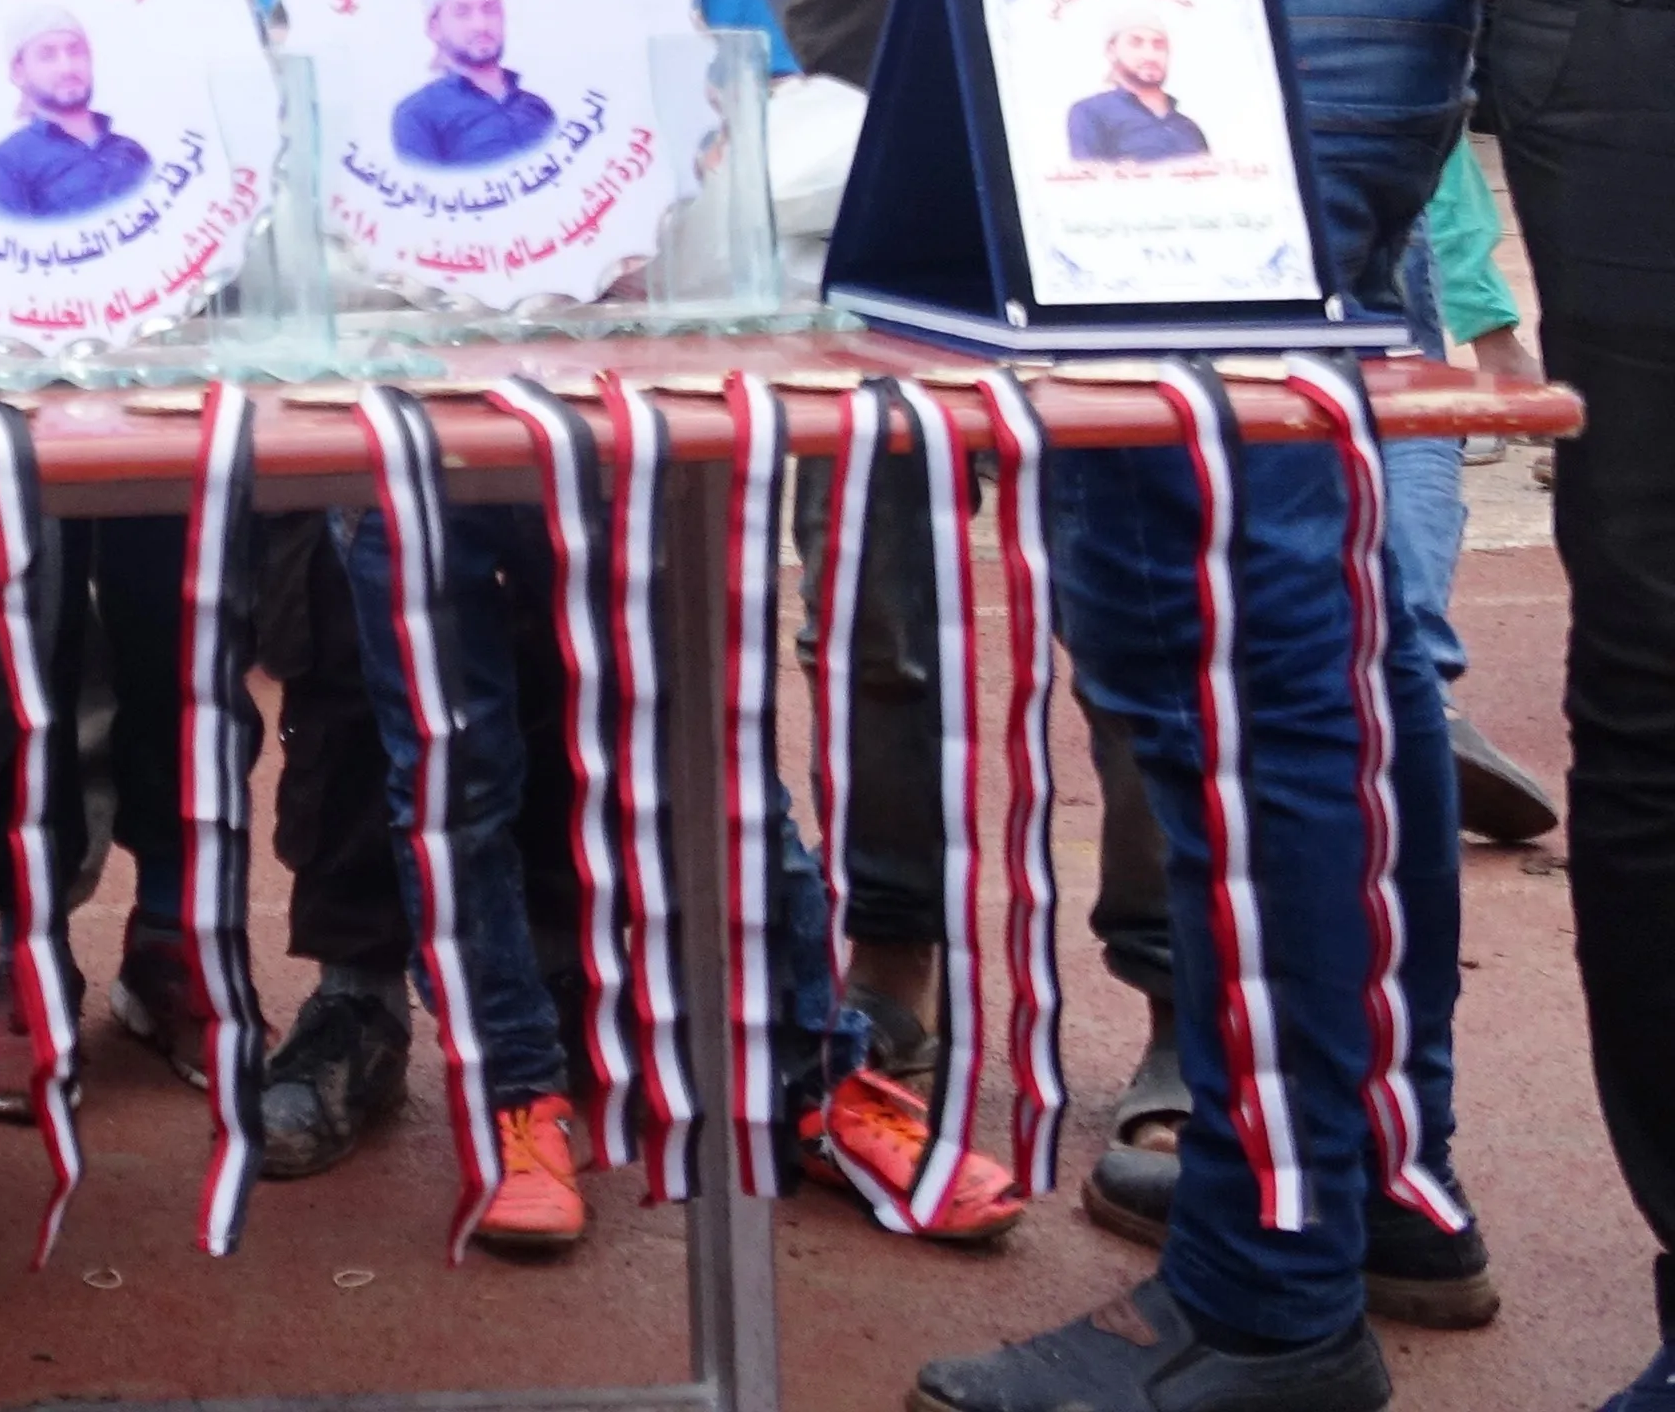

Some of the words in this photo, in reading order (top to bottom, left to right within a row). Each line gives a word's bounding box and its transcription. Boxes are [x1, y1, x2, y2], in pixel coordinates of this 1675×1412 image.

[519, 154, 563, 199] لجنة
[606, 125, 654, 183] دورة
[210, 166, 258, 226] دورة
[340, 140, 438, 219] والرياضة
[442, 182, 515, 223] الشباب
[115, 199, 162, 246] لجنة
[561, 173, 622, 250] الشهيد
[34, 231, 112, 276] الشباب
[162, 219, 224, 297] الشهيد
[502, 233, 558, 281] سالم
[103, 282, 159, 327] سالم
